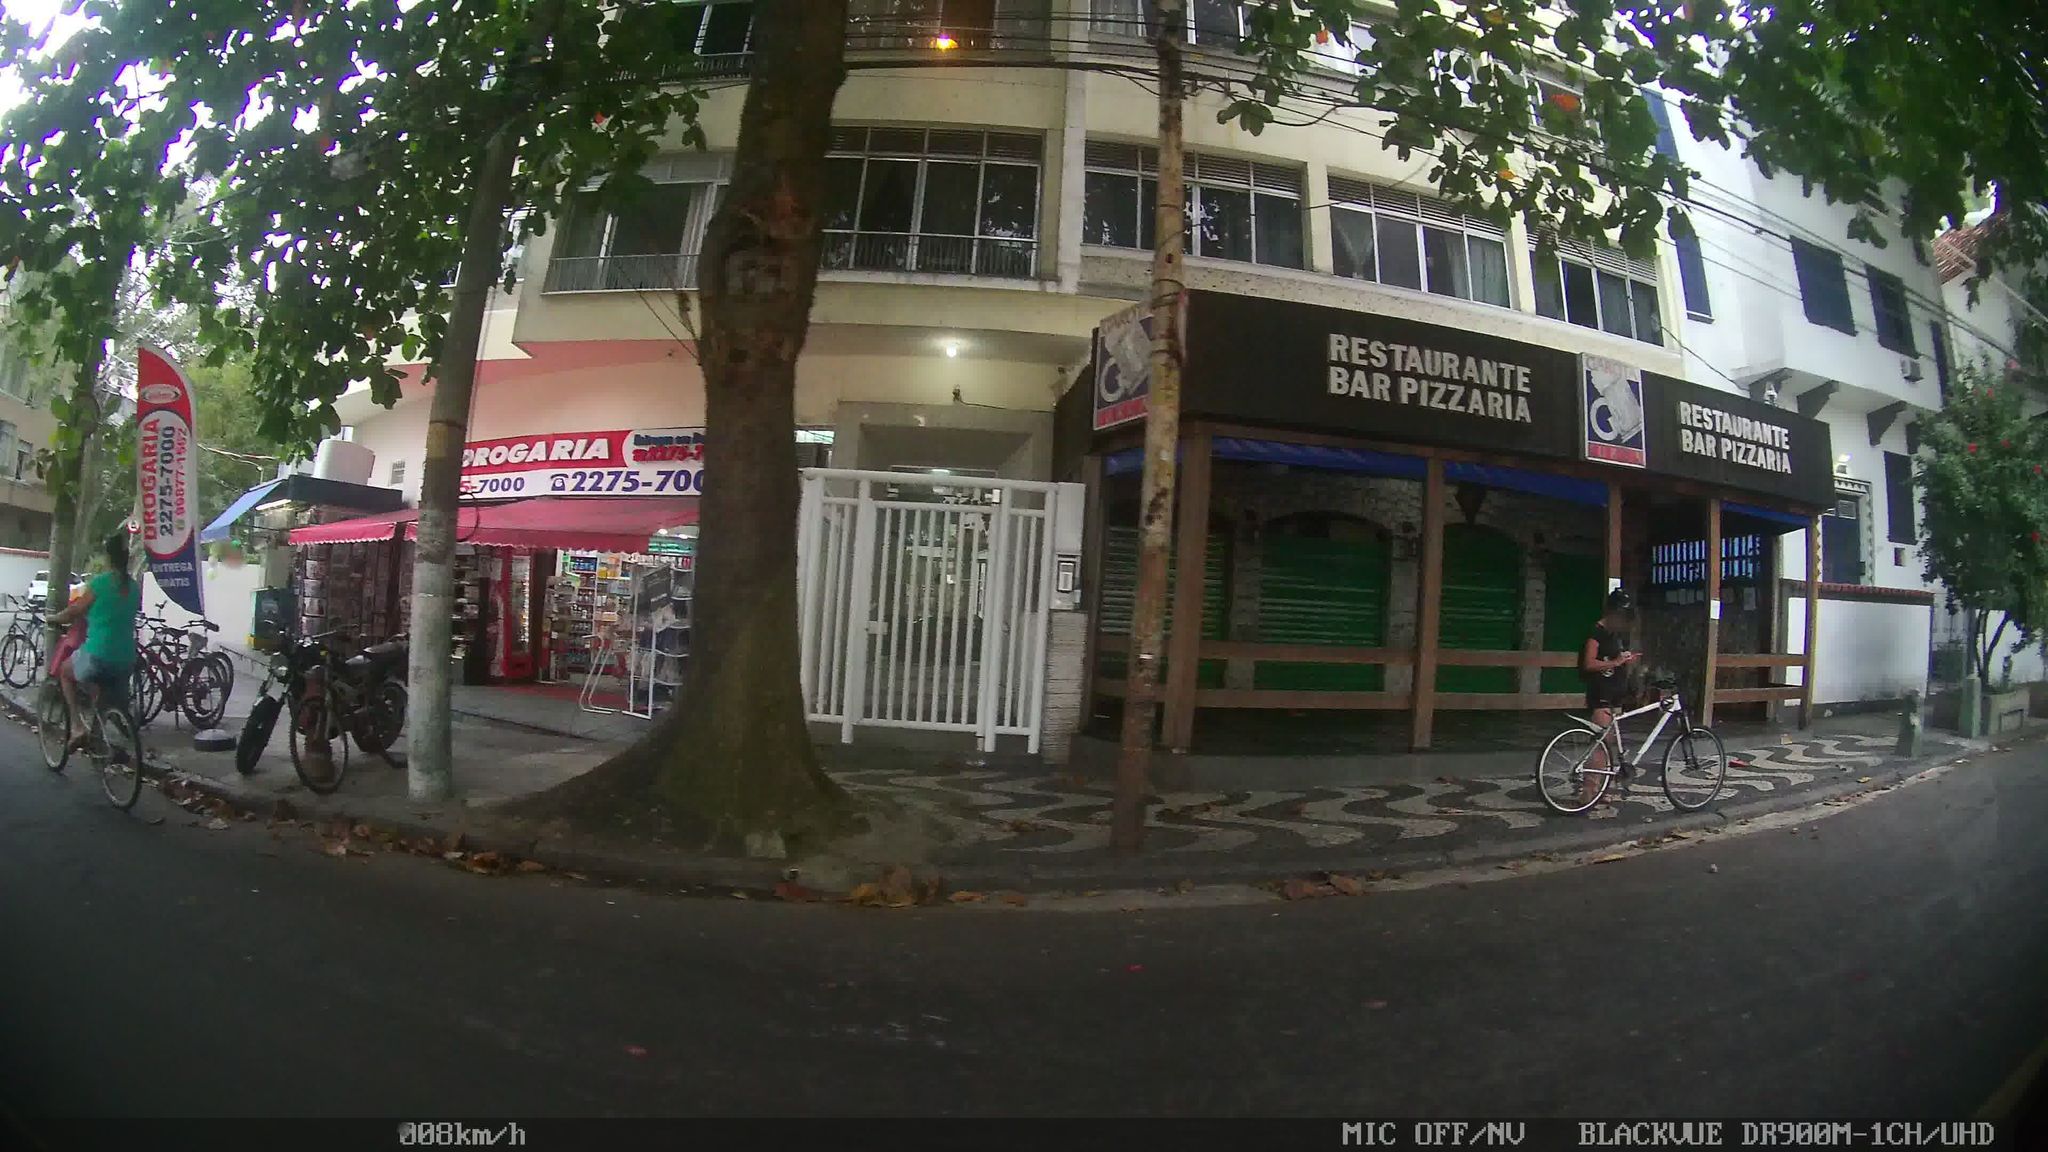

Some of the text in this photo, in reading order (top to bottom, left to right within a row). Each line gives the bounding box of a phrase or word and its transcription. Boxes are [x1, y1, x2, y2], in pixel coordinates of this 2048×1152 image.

[1328, 333, 1532, 393] RESTAURANTE
[1328, 366, 1532, 423] BAR PIZZARIA
[1680, 401, 1790, 450] RESTAURANTE
[1681, 429, 1717, 458] BAR
[1721, 437, 1792, 474] PIZZARIA
[142, 419, 160, 540] DROGARIA
[461, 438, 610, 468] DROGARIA
[159, 426, 175, 537] 2275-7000
[151, 562, 193, 572] ENTREGA
